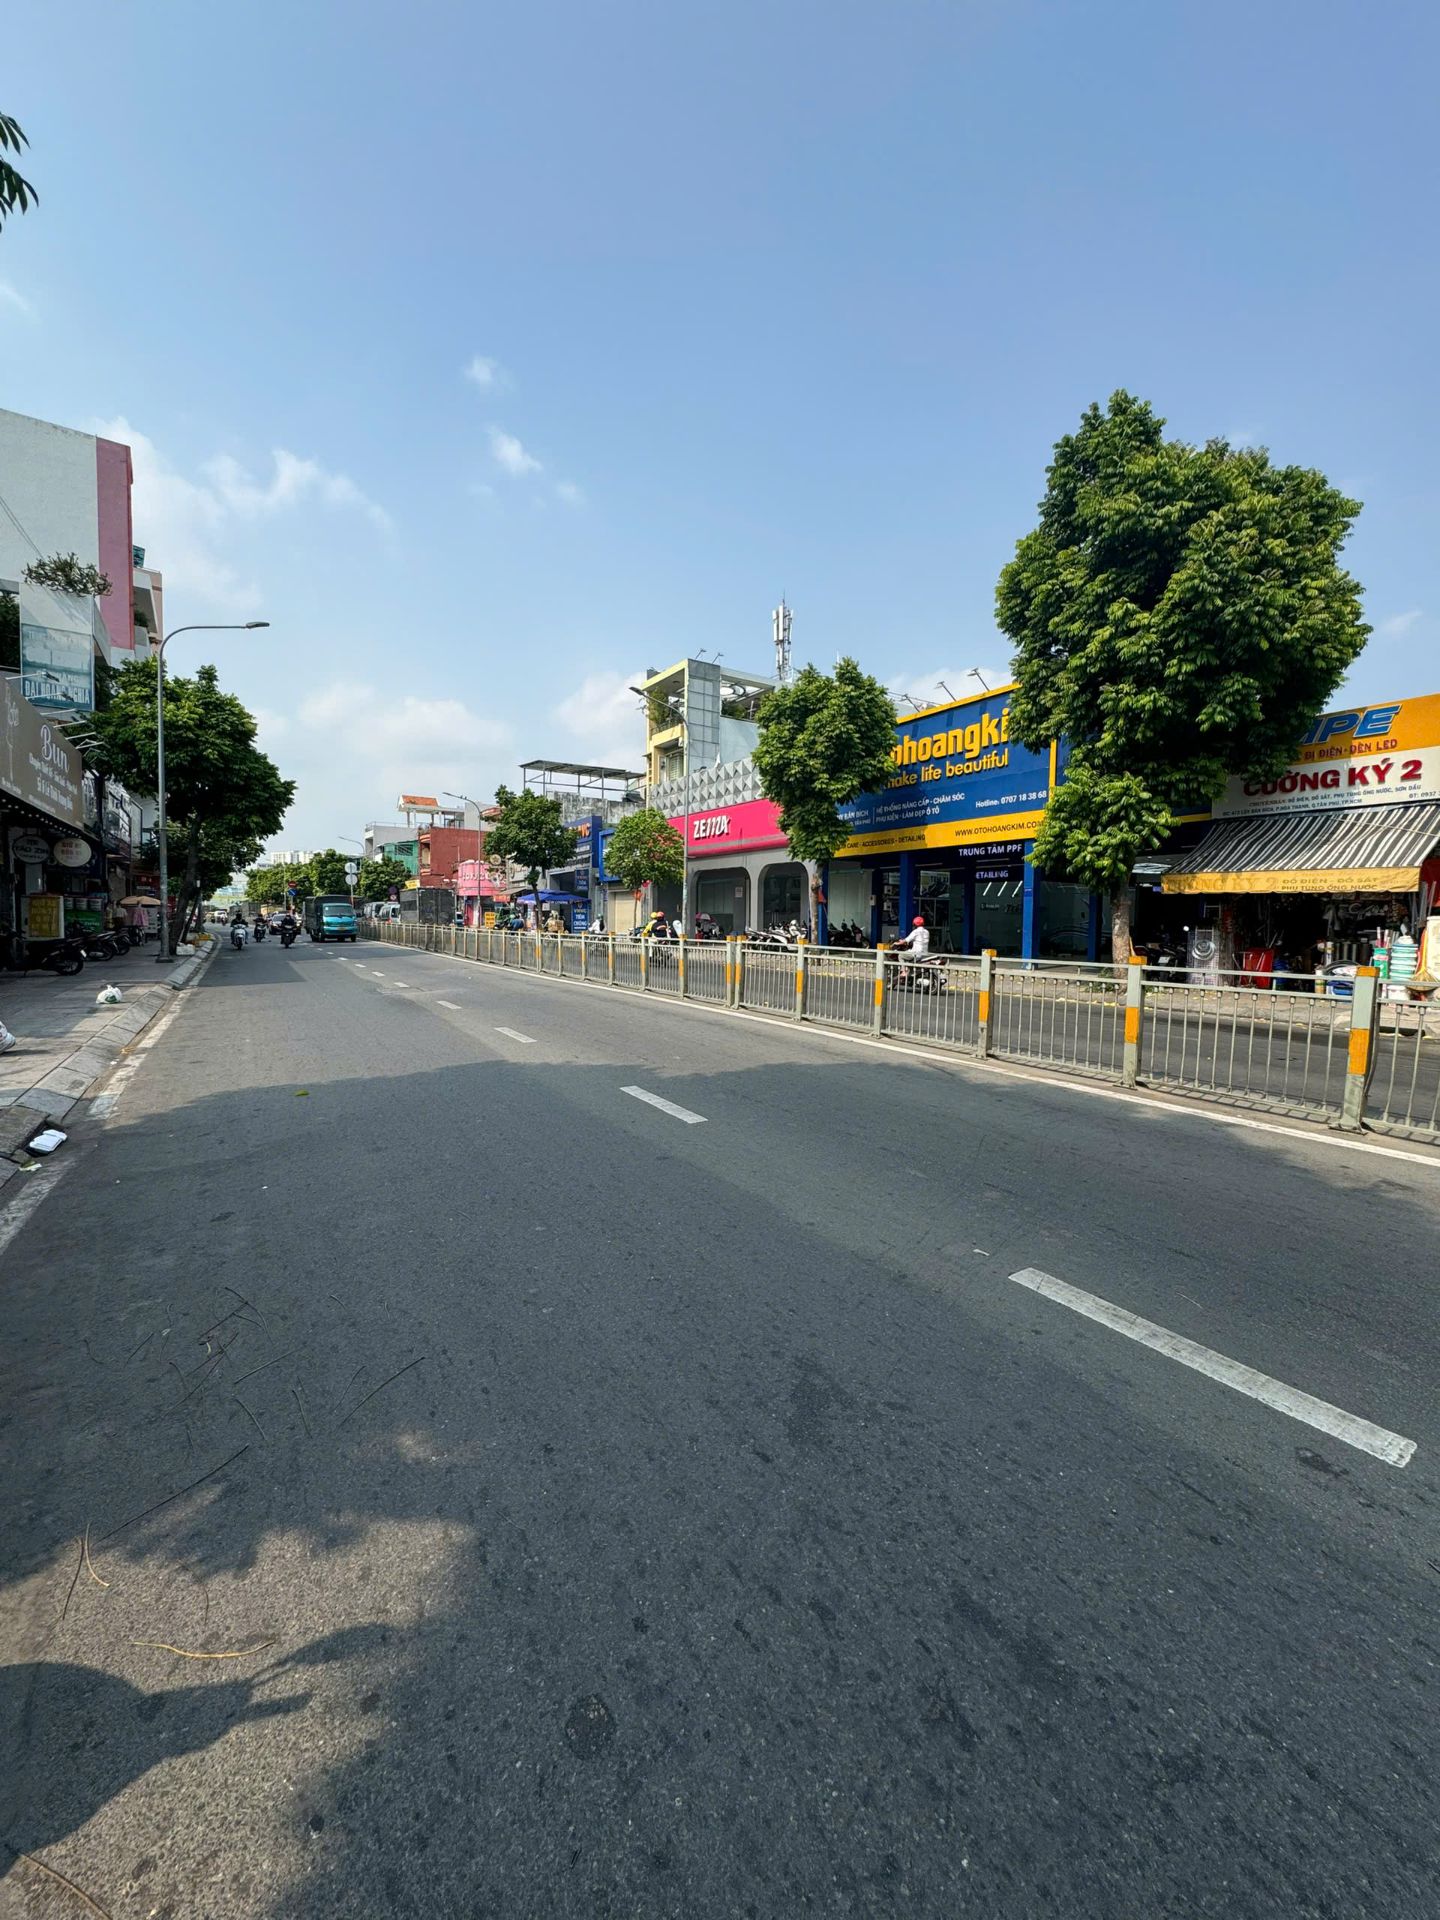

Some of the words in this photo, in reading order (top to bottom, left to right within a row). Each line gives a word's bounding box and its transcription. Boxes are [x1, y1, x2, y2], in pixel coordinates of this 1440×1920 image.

[40, 724, 69, 774] Bun
[1376, 738, 1398, 751] LED
[921, 764, 942, 782] life
[946, 748, 1008, 777] beautiful
[1347, 758, 1395, 787] KÝ
[1400, 760, 1423, 782] 2
[952, 791, 965, 802] SÓC
[1018, 793, 1027, 802] 18
[932, 803, 941, 815] TÔ
[959, 847, 985, 857] TRUNG
[987, 843, 1005, 855] TÂM
[1006, 844, 1022, 853] PPF
